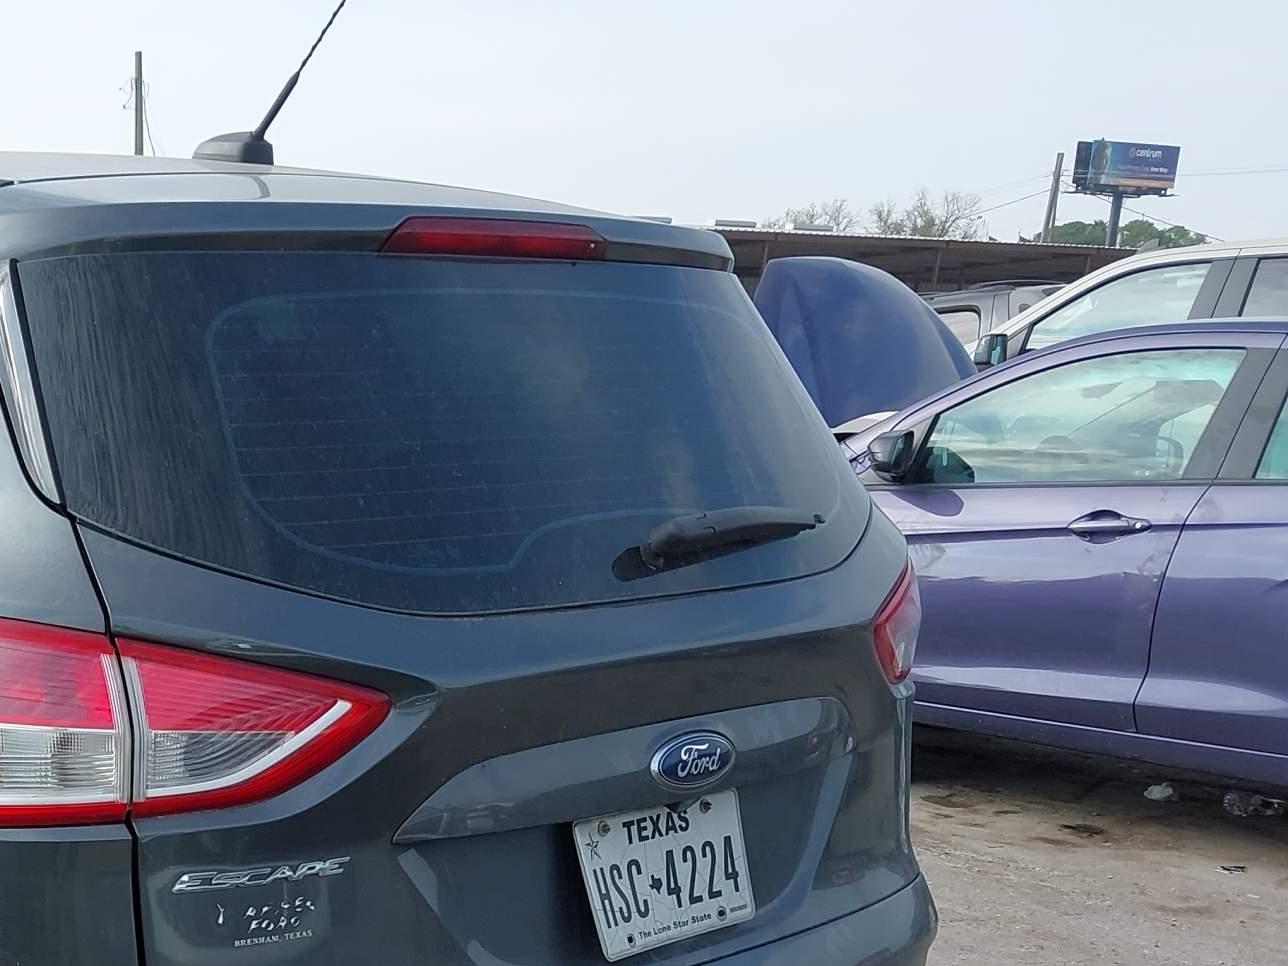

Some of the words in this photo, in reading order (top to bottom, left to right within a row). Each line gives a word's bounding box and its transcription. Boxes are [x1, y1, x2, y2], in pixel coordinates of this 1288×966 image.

[677, 743, 721, 778] Ford
[622, 809, 690, 845] TEXAS
[171, 856, 352, 894] ESCAPE
[592, 859, 650, 930] HSC
[664, 835, 741, 909] 4224
[283, 929, 313, 942] TEXAS
[638, 930, 652, 941] The
[653, 924, 672, 936] Lone
[672, 919, 689, 930] Star
[691, 912, 712, 924] State
